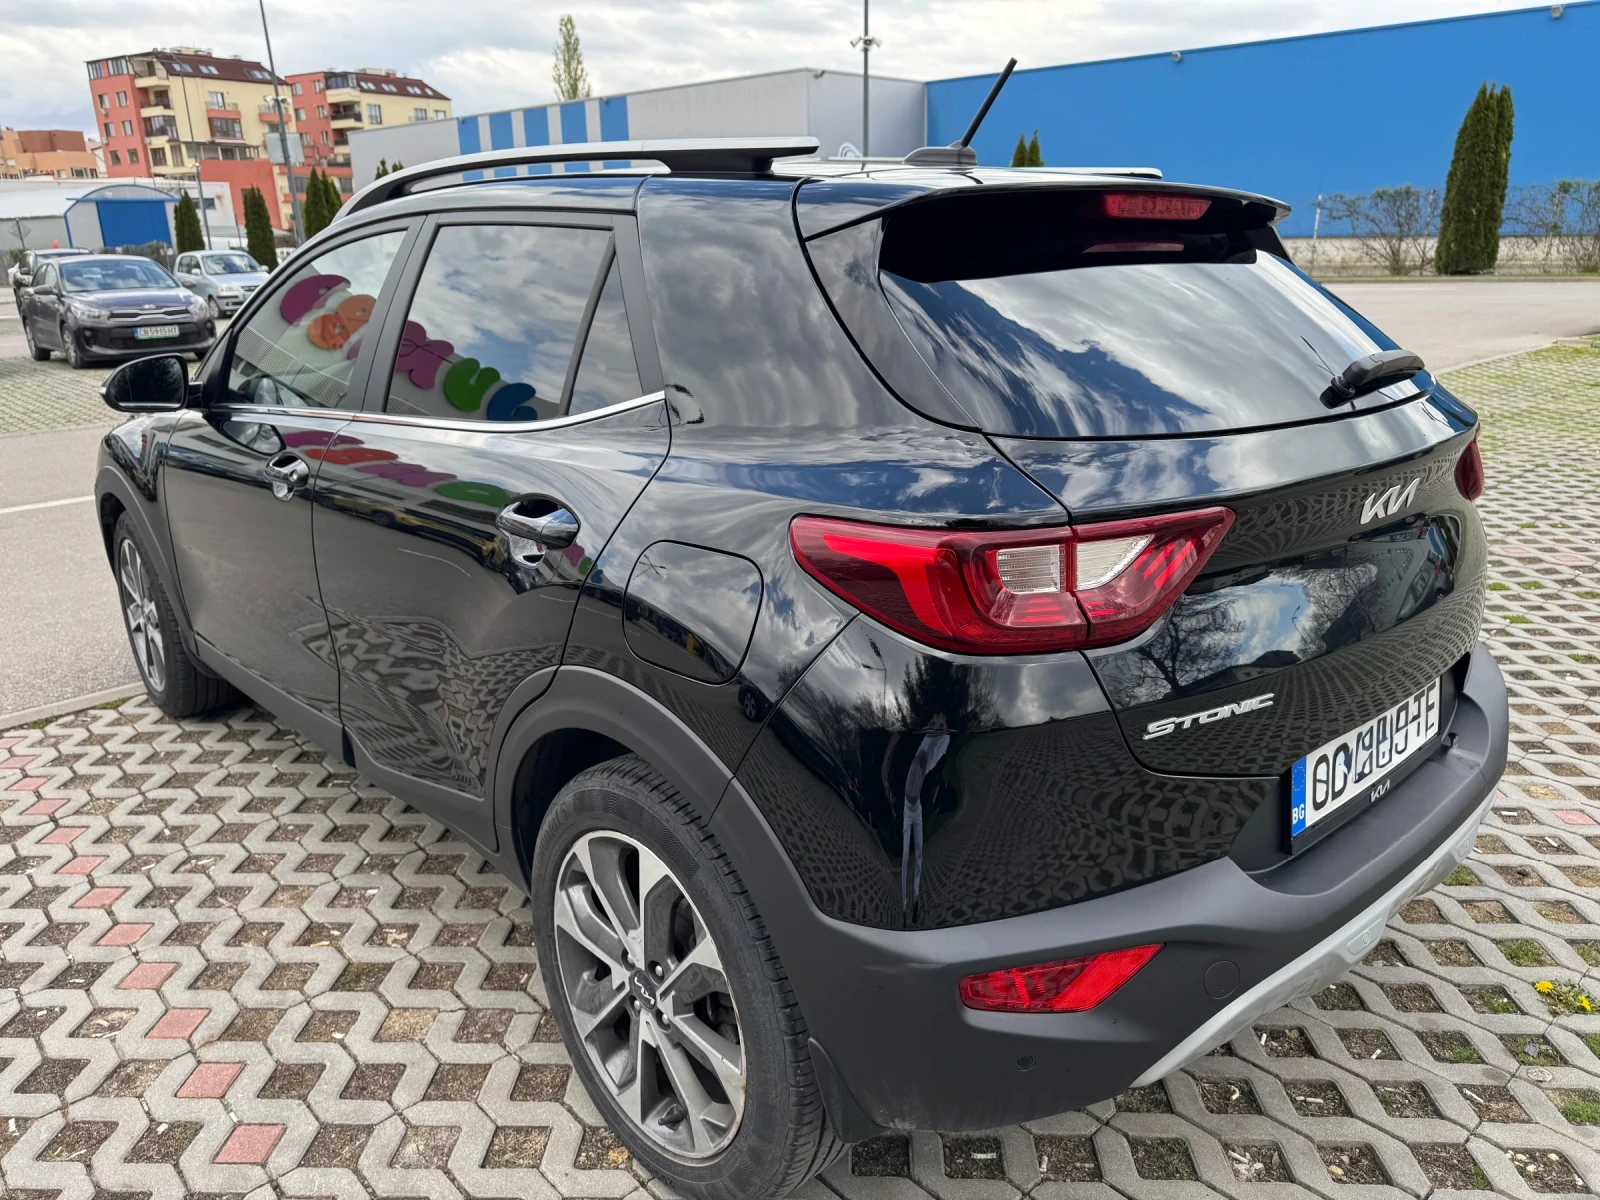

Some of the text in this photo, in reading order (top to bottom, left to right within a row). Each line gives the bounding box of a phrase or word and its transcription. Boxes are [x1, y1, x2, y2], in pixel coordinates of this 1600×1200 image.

[1360, 477, 1420, 525] KIA
[1142, 692, 1275, 740] STONIC
[1292, 803, 1305, 825] BG
